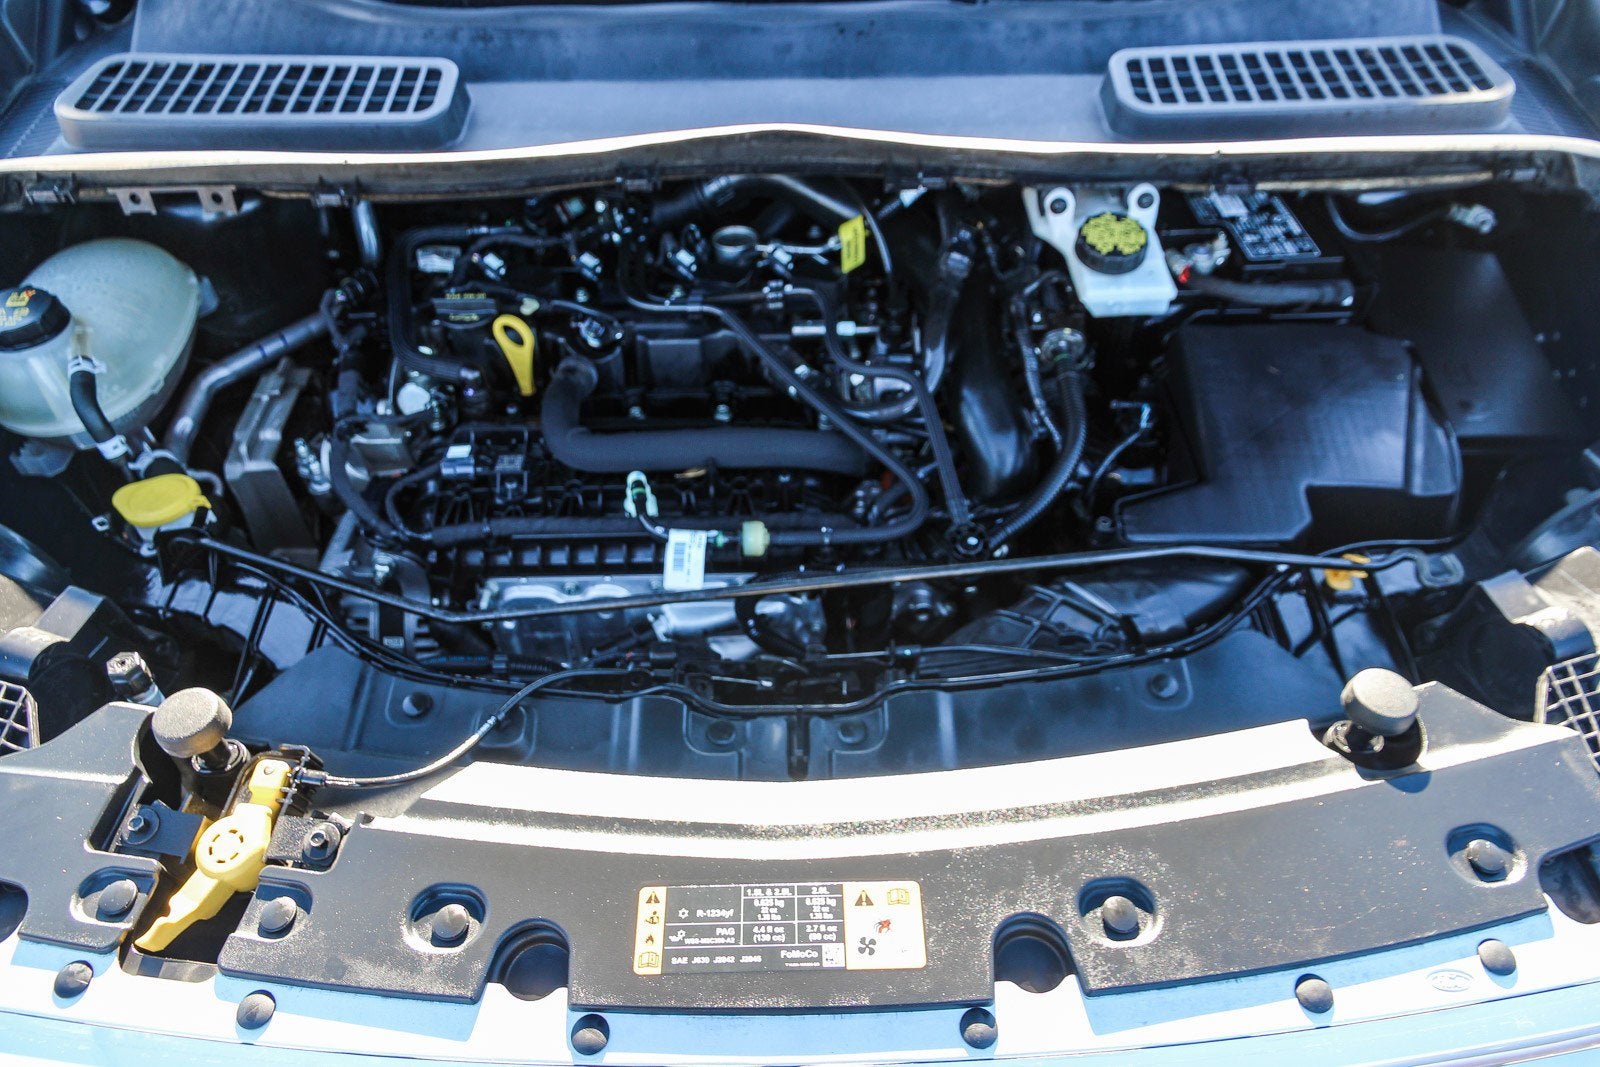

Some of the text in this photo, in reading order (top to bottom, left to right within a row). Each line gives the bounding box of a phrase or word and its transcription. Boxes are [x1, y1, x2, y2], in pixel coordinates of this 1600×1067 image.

[765, 888, 773, 896] &
[696, 908, 735, 919] R-1234yf
[715, 927, 736, 936] PAG
[752, 925, 766, 934] 4.4
[805, 924, 819, 933] 2.7
[780, 949, 819, 959] FoMoCo
[671, 956, 688, 965] SAE
